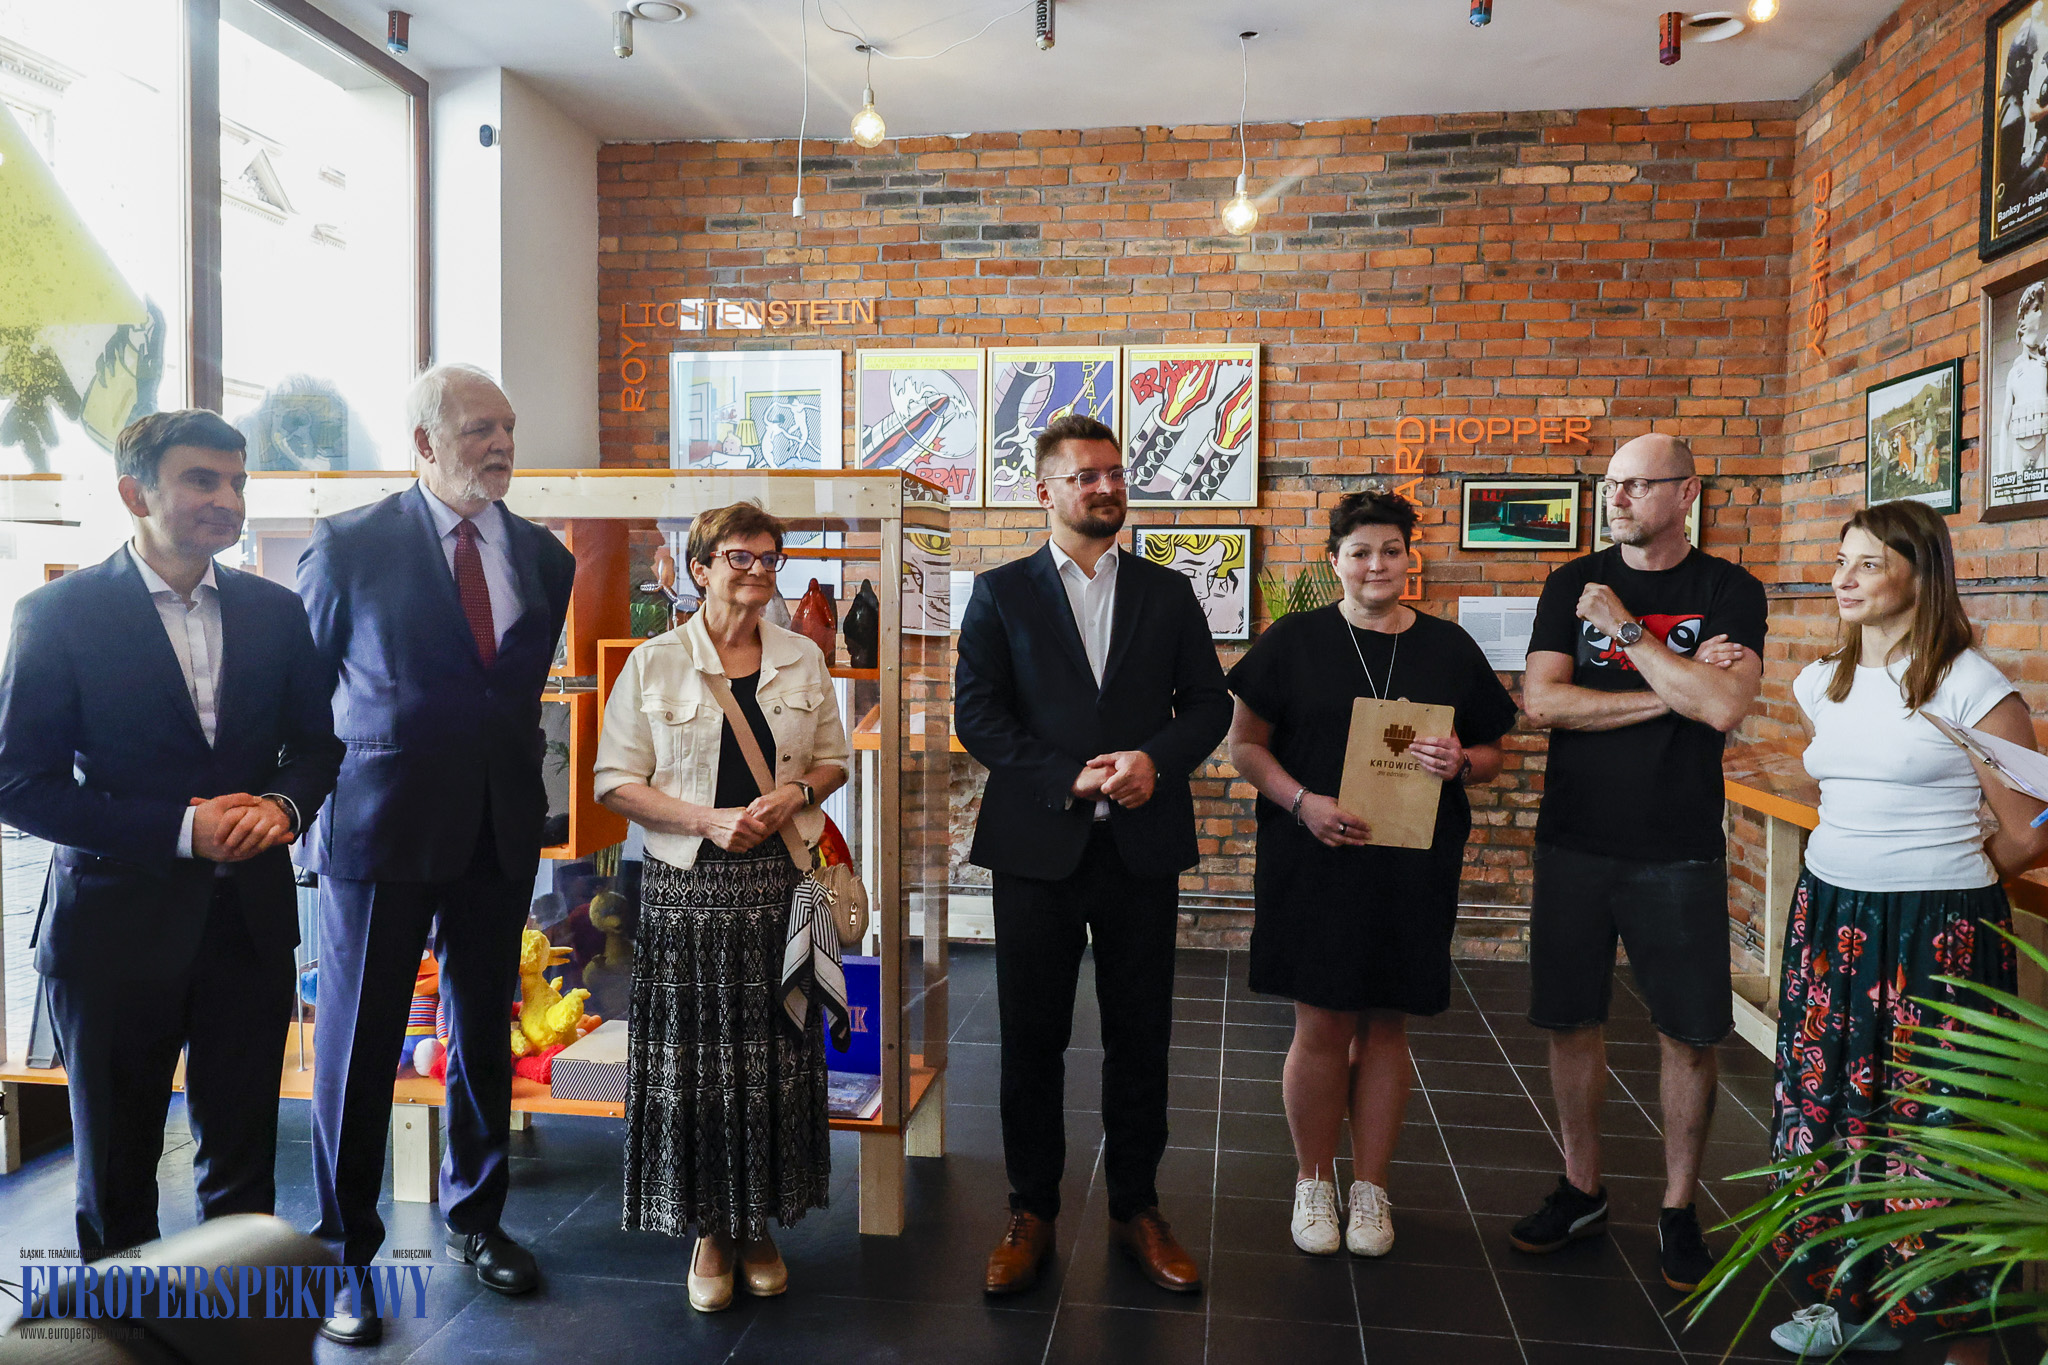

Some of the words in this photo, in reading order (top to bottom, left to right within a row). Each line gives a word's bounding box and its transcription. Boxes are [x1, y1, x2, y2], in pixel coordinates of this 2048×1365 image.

[1998, 203, 2021, 222] Banksy
[1806, 171, 1831, 357] BANKSY
[621, 299, 875, 328] LICHTENSTEIN
[621, 334, 647, 411] ROY
[1429, 417, 1592, 444] HOPPER
[1993, 473, 2016, 487] Banksy
[2024, 469, 2044, 481] Bristol
[1370, 759, 1420, 771] KATOWICE
